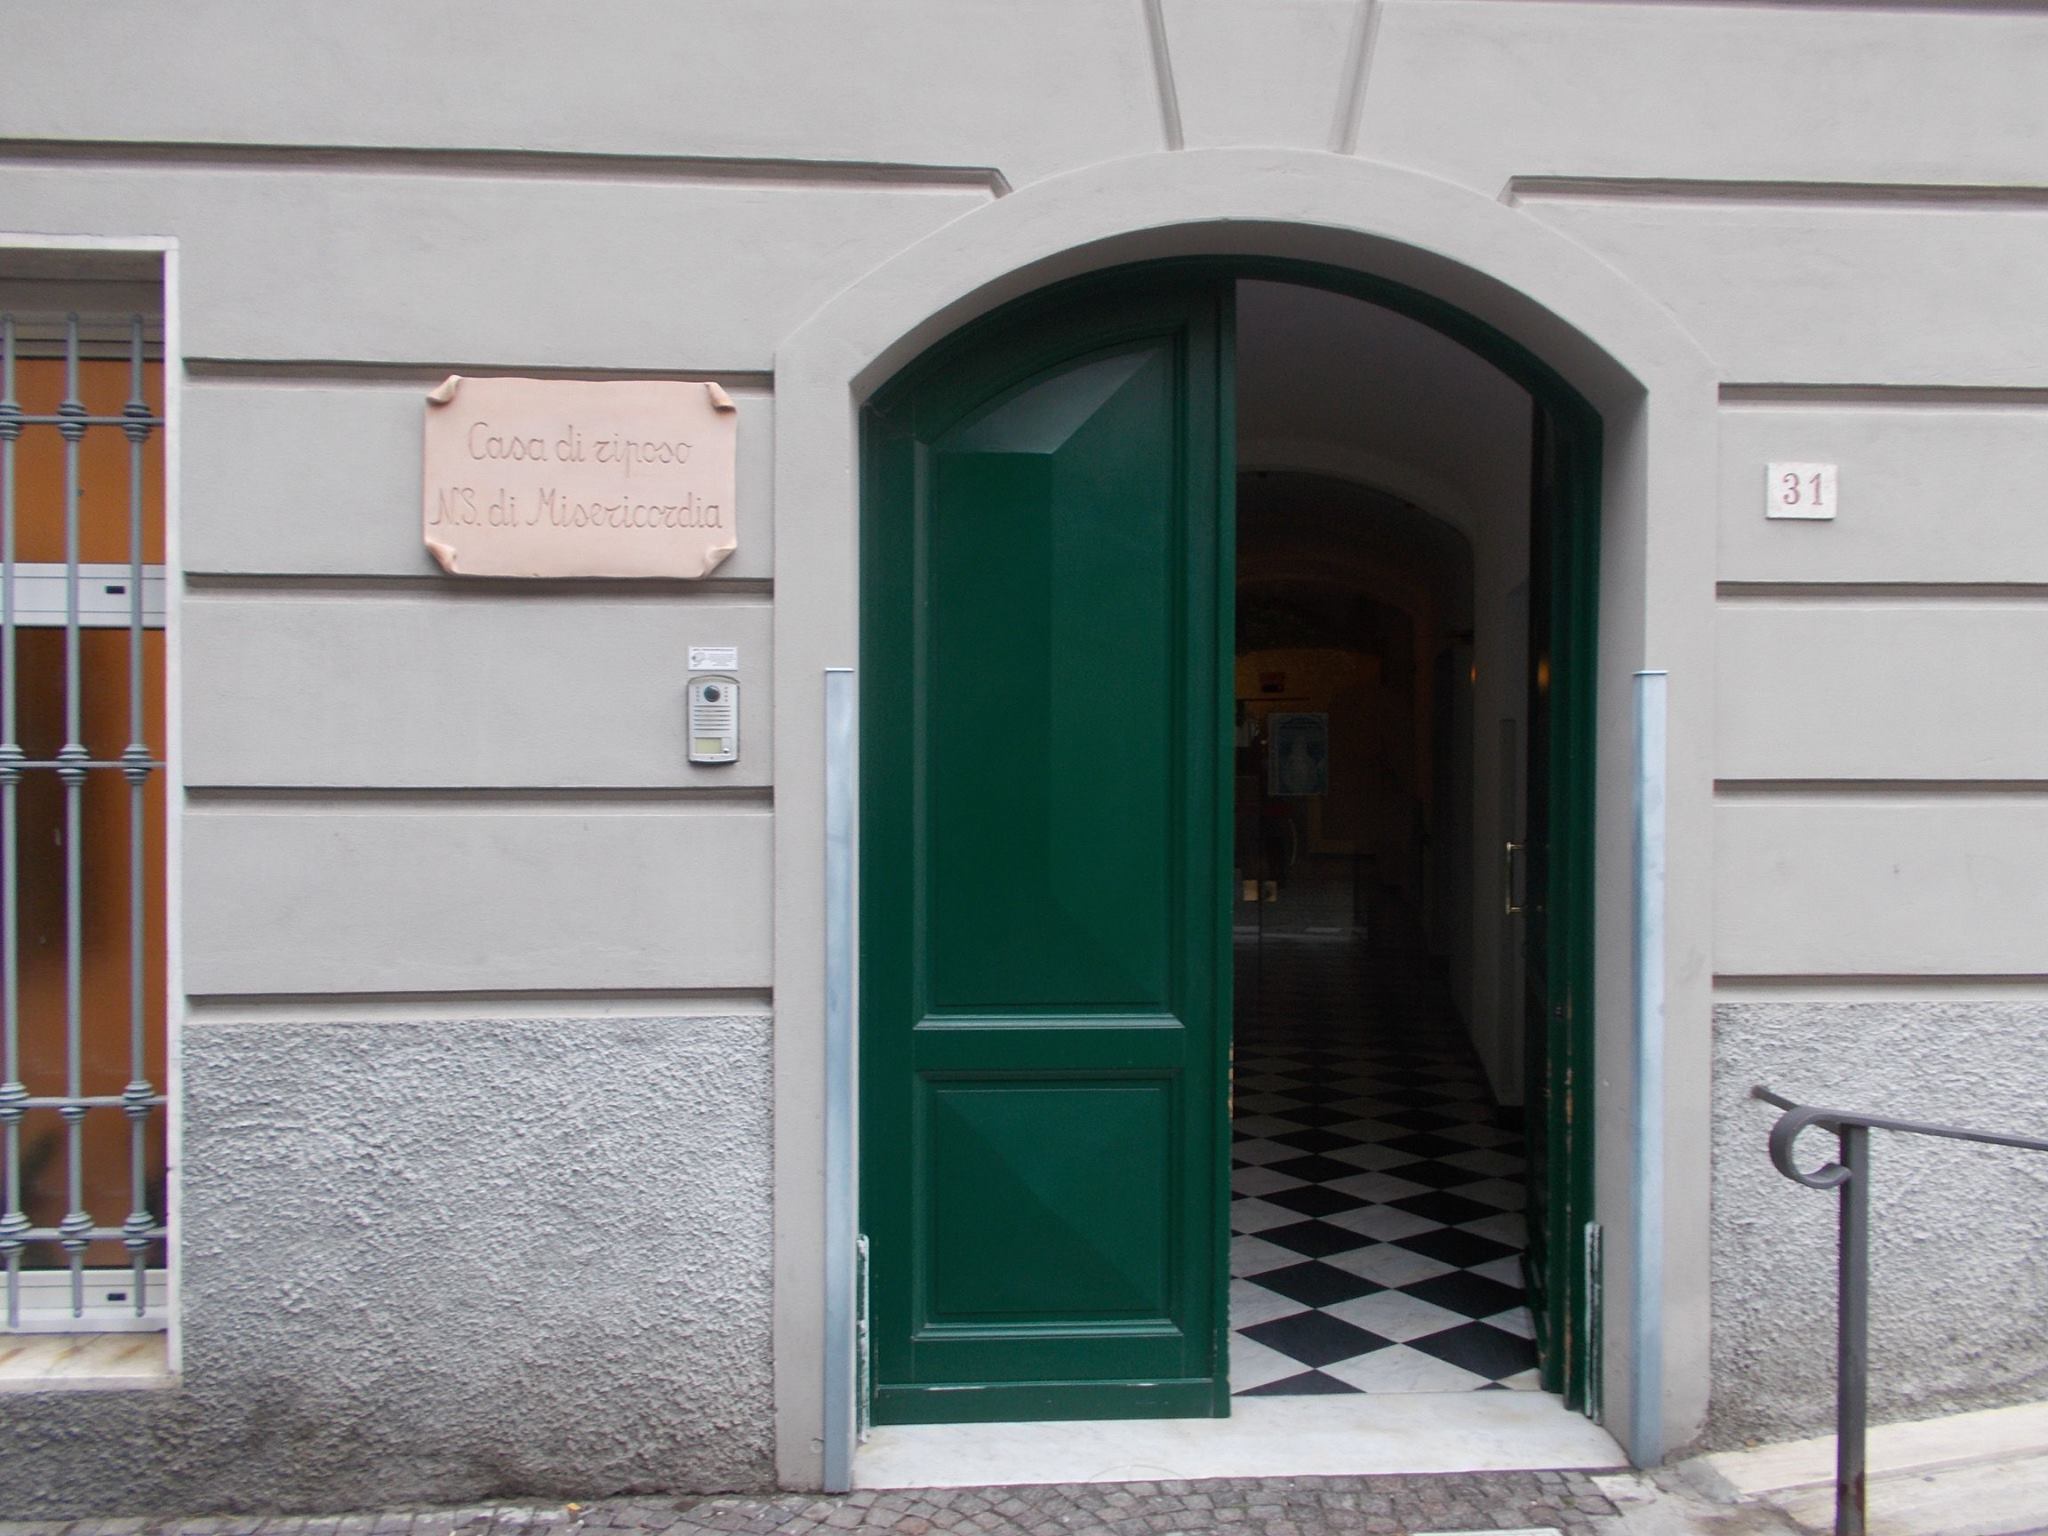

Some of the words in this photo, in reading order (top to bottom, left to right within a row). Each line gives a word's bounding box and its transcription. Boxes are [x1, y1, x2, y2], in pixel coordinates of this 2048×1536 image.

[468, 421, 548, 462] Casa
[555, 424, 586, 463] di
[593, 432, 693, 478] riposo
[488, 488, 518, 528] di
[526, 487, 723, 529] Misericordia
[1783, 472, 1824, 506] 31
